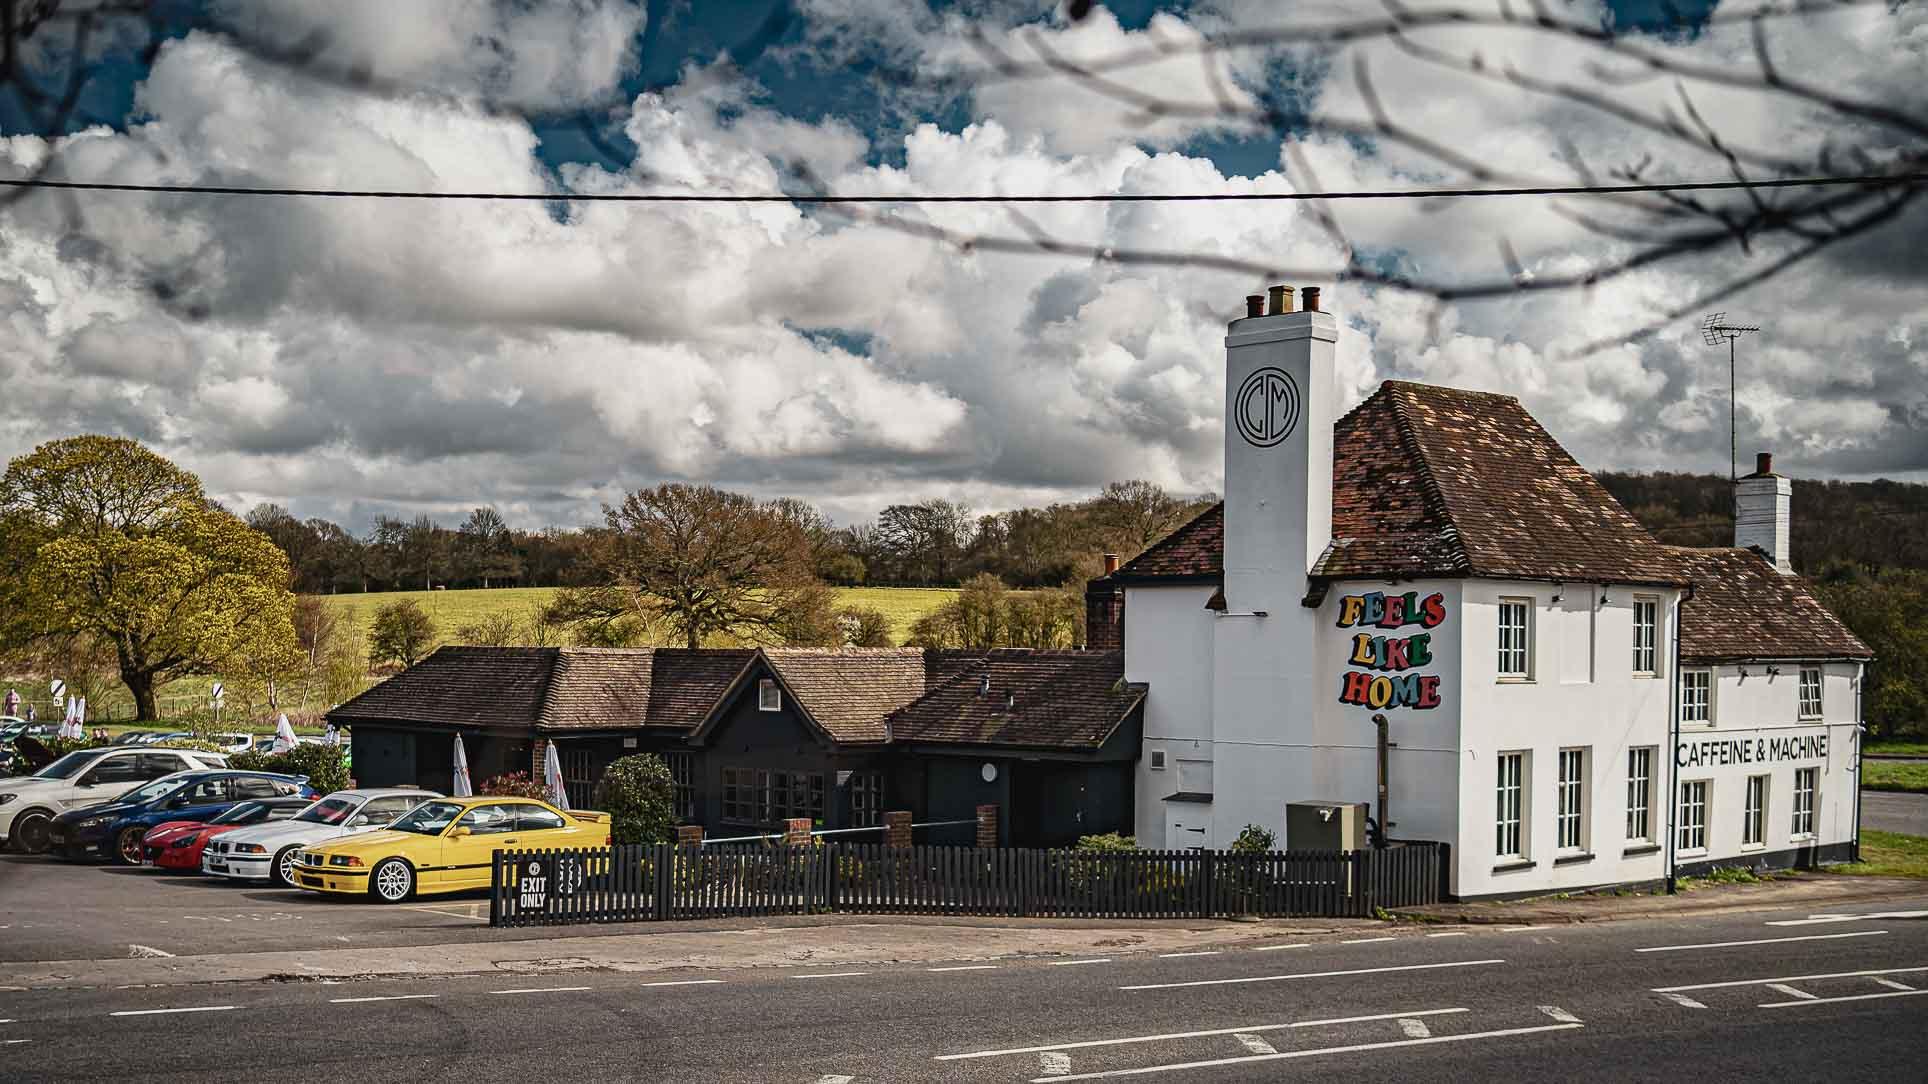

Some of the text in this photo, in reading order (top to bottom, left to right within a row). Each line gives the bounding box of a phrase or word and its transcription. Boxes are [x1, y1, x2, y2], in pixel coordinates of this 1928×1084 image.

[1336, 591, 1446, 629] FEELS
[1348, 633, 1432, 671] LIKE
[1339, 671, 1441, 710] HOME
[1677, 735, 1827, 767] CAFFEINE & MACHINE
[520, 893, 546, 908] ONLY
[521, 876, 547, 893] EXIT
